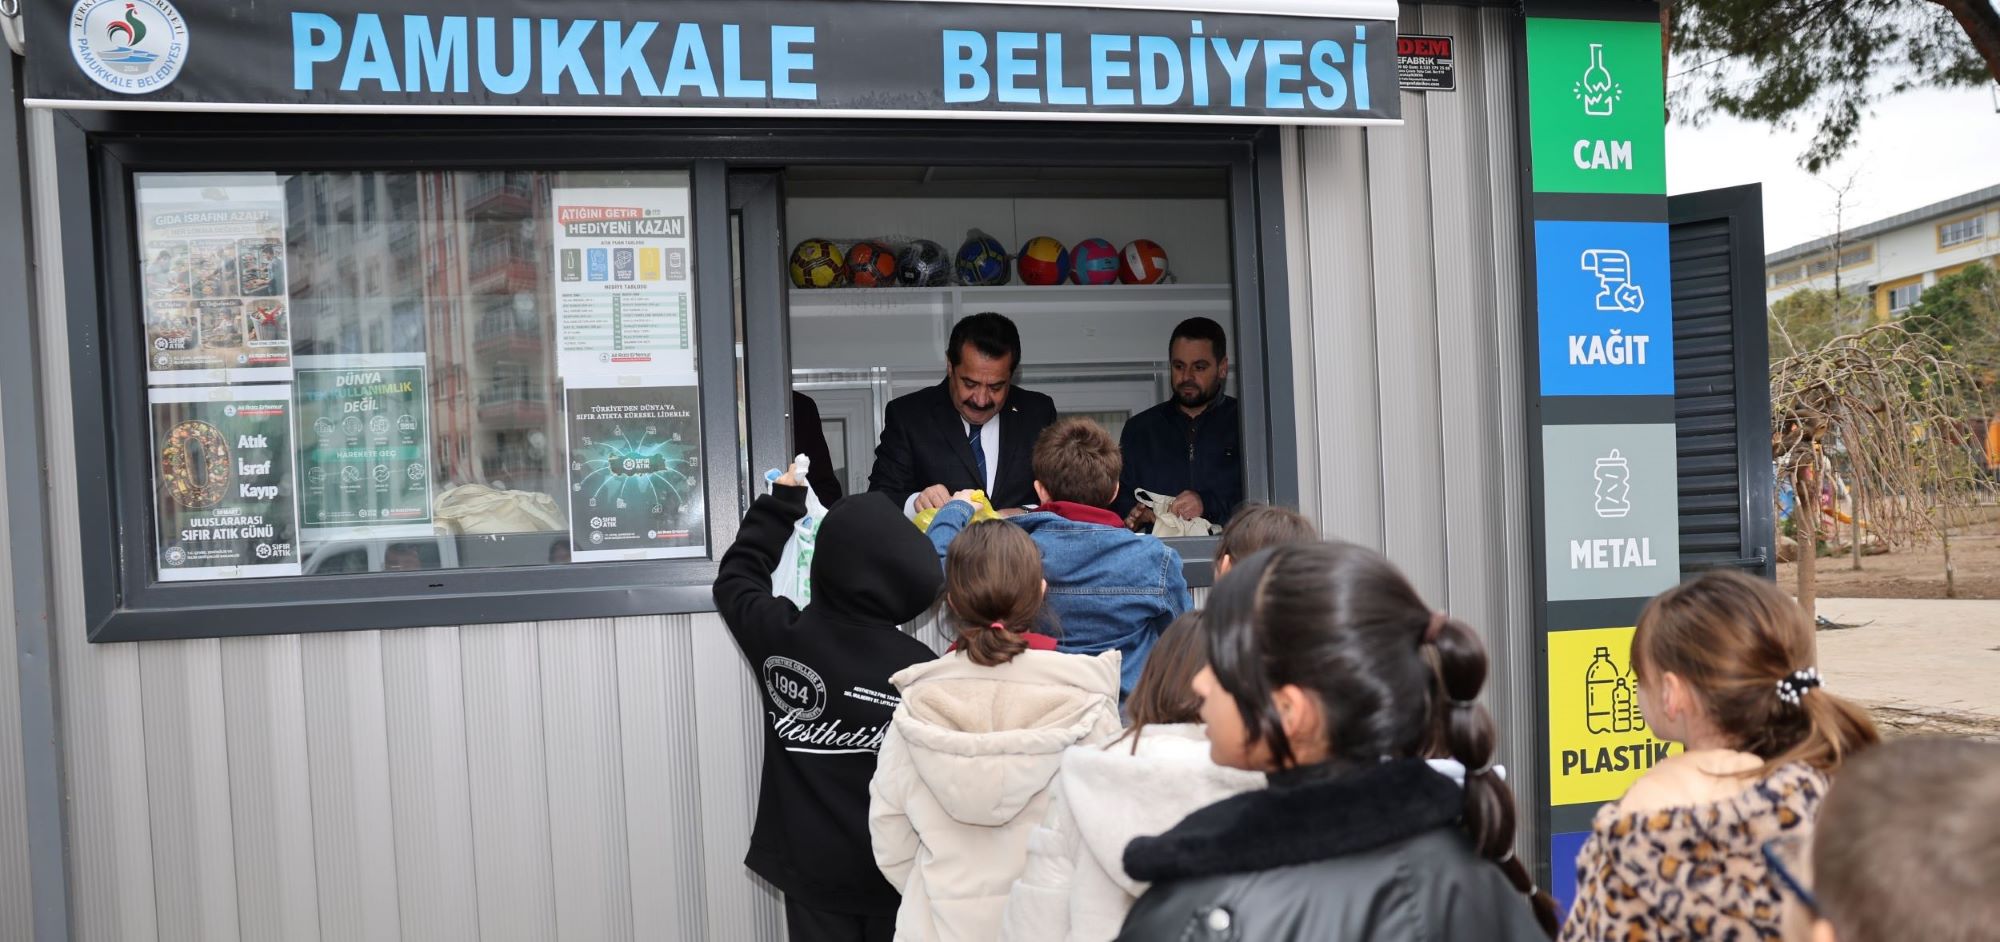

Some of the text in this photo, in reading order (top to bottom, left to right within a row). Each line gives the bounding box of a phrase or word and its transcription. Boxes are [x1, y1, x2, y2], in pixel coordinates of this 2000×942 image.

[78, 38, 182, 88] PAMUKKALE BELEDİYESİ
[291, 12, 1370, 111] PAMUKKALE BELEDİYESİ
[1573, 140, 1633, 171] CAM
[155, 214, 182, 226] GIDA
[561, 208, 602, 220] ATIĞINI
[635, 218, 681, 235] KAZAN
[1568, 328, 1650, 366] KAĞIT
[336, 372, 382, 388] DÜNYA
[344, 396, 379, 413] DEĞİL
[237, 434, 268, 449] Atık
[238, 458, 272, 476] İsraf
[240, 483, 278, 500] Kayıp
[190, 516, 263, 528] ULUSLARARASI
[182, 524, 274, 541] SIFIR ATIK GÜNÜ
[1570, 536, 1657, 570] METAL
[775, 671, 809, 704] 1994
[769, 708, 889, 749] Aesthetik
[1561, 738, 1672, 776] PLASTİK
